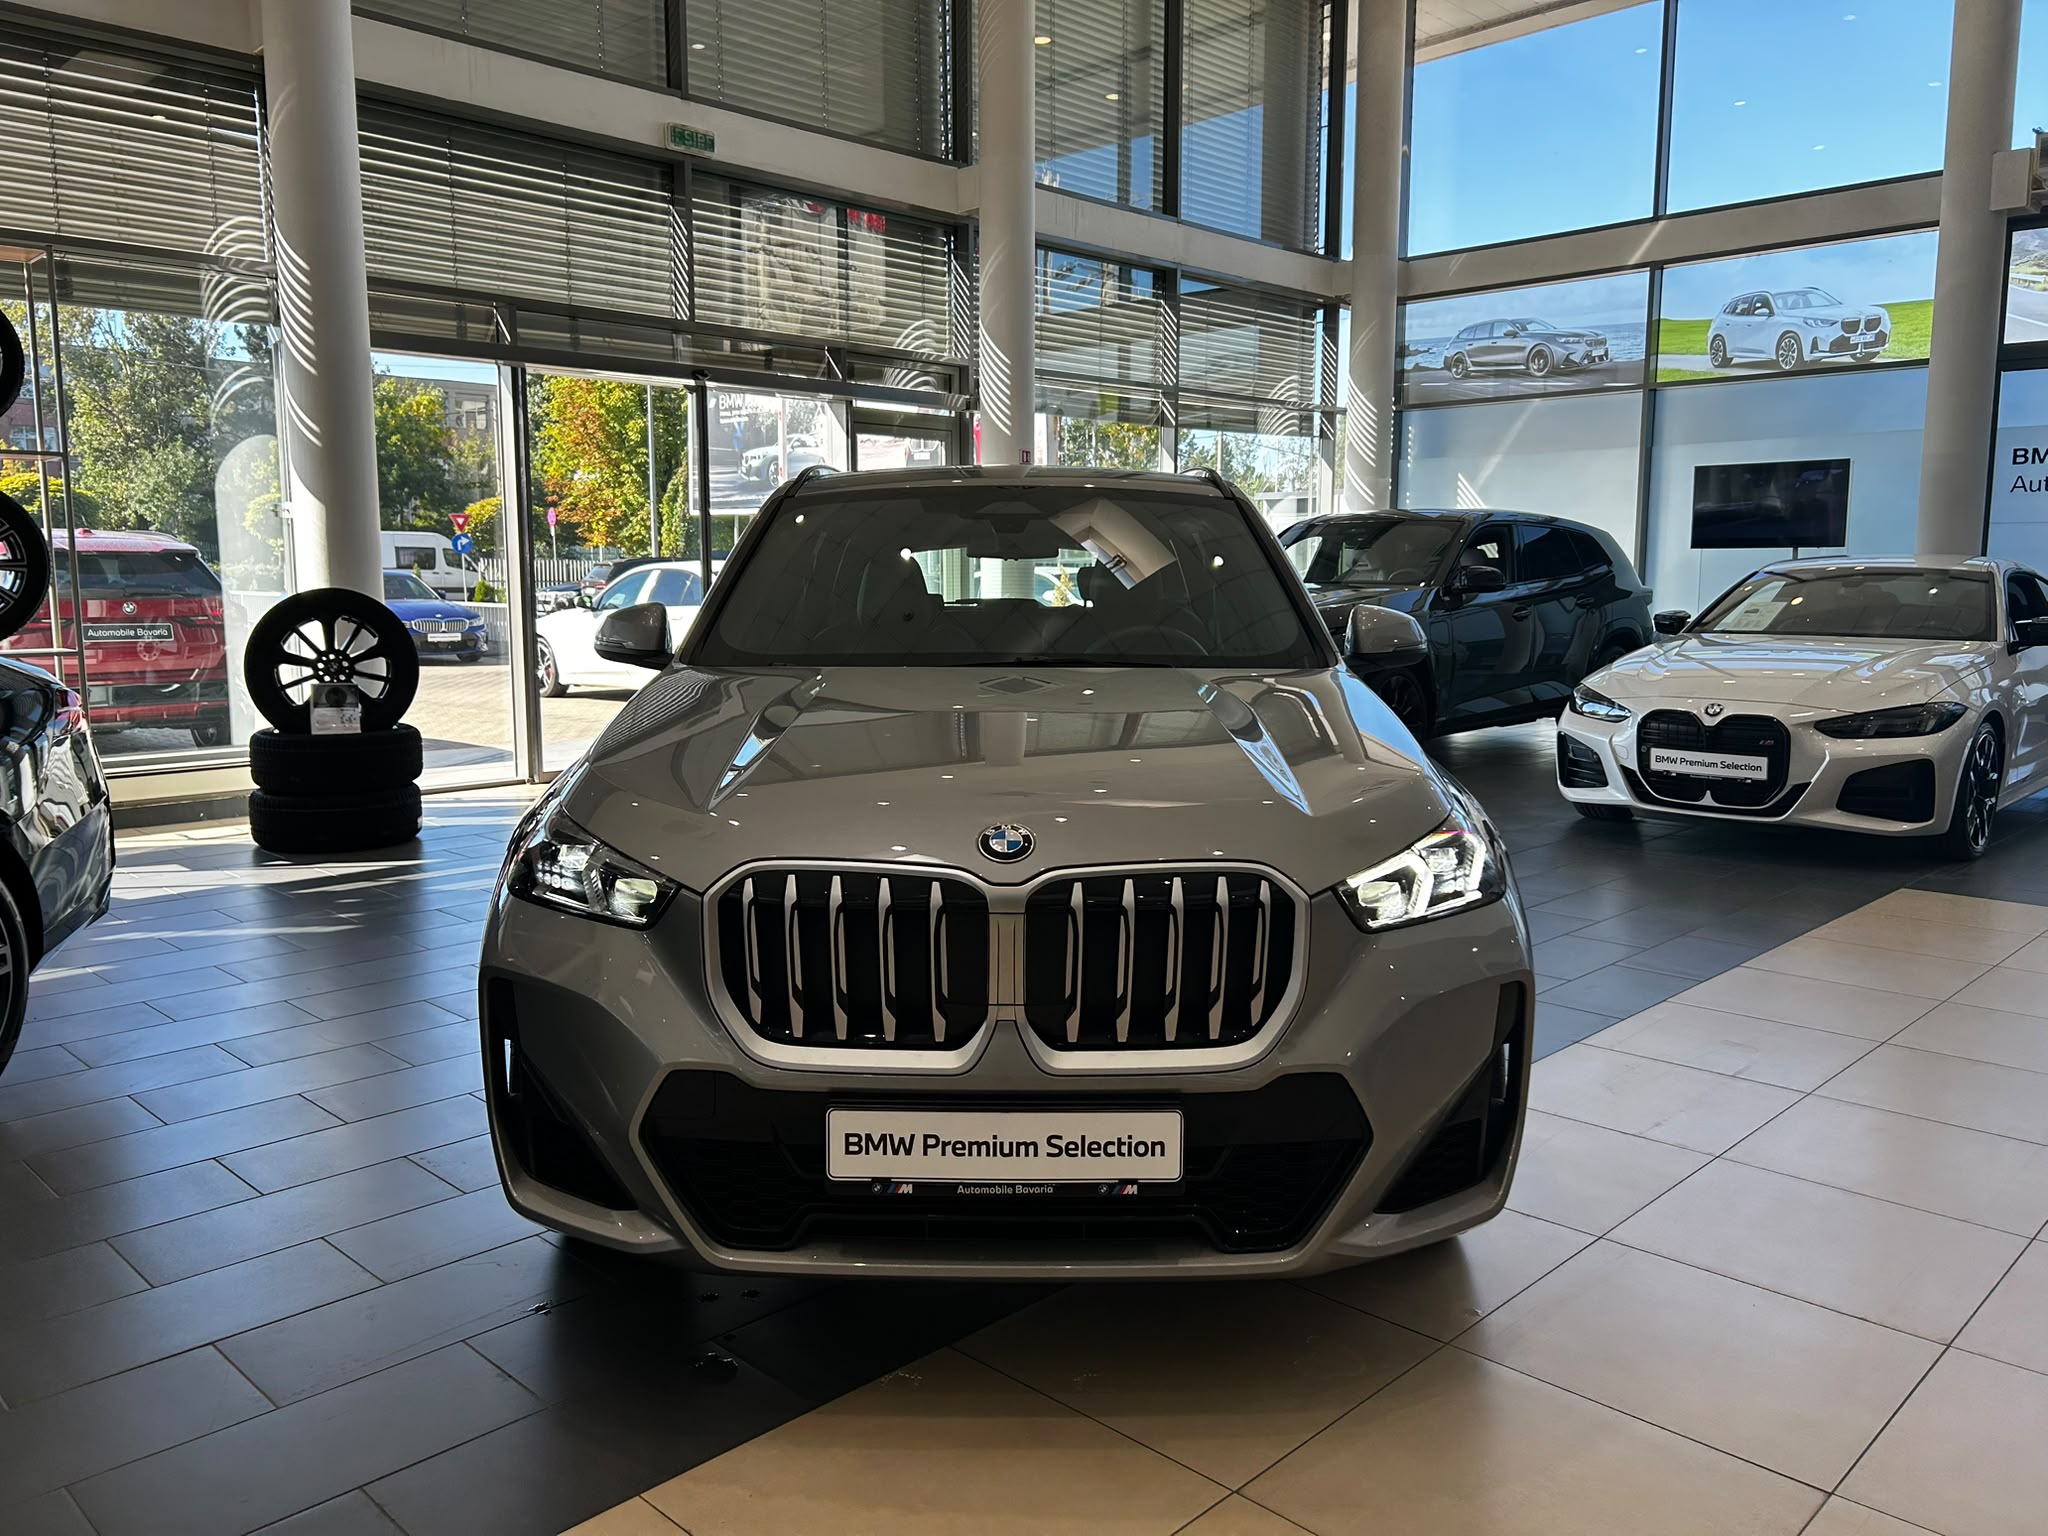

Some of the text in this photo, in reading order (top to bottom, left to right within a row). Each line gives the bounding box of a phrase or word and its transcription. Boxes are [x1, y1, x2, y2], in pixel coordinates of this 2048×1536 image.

[87, 628, 168, 637] Automobile Bavaria
[1655, 755, 1762, 772] BMW Premium Selection
[844, 1133, 1166, 1158] BMW Premium Selection
[956, 1184, 1054, 1195] Automobile Bavaria
